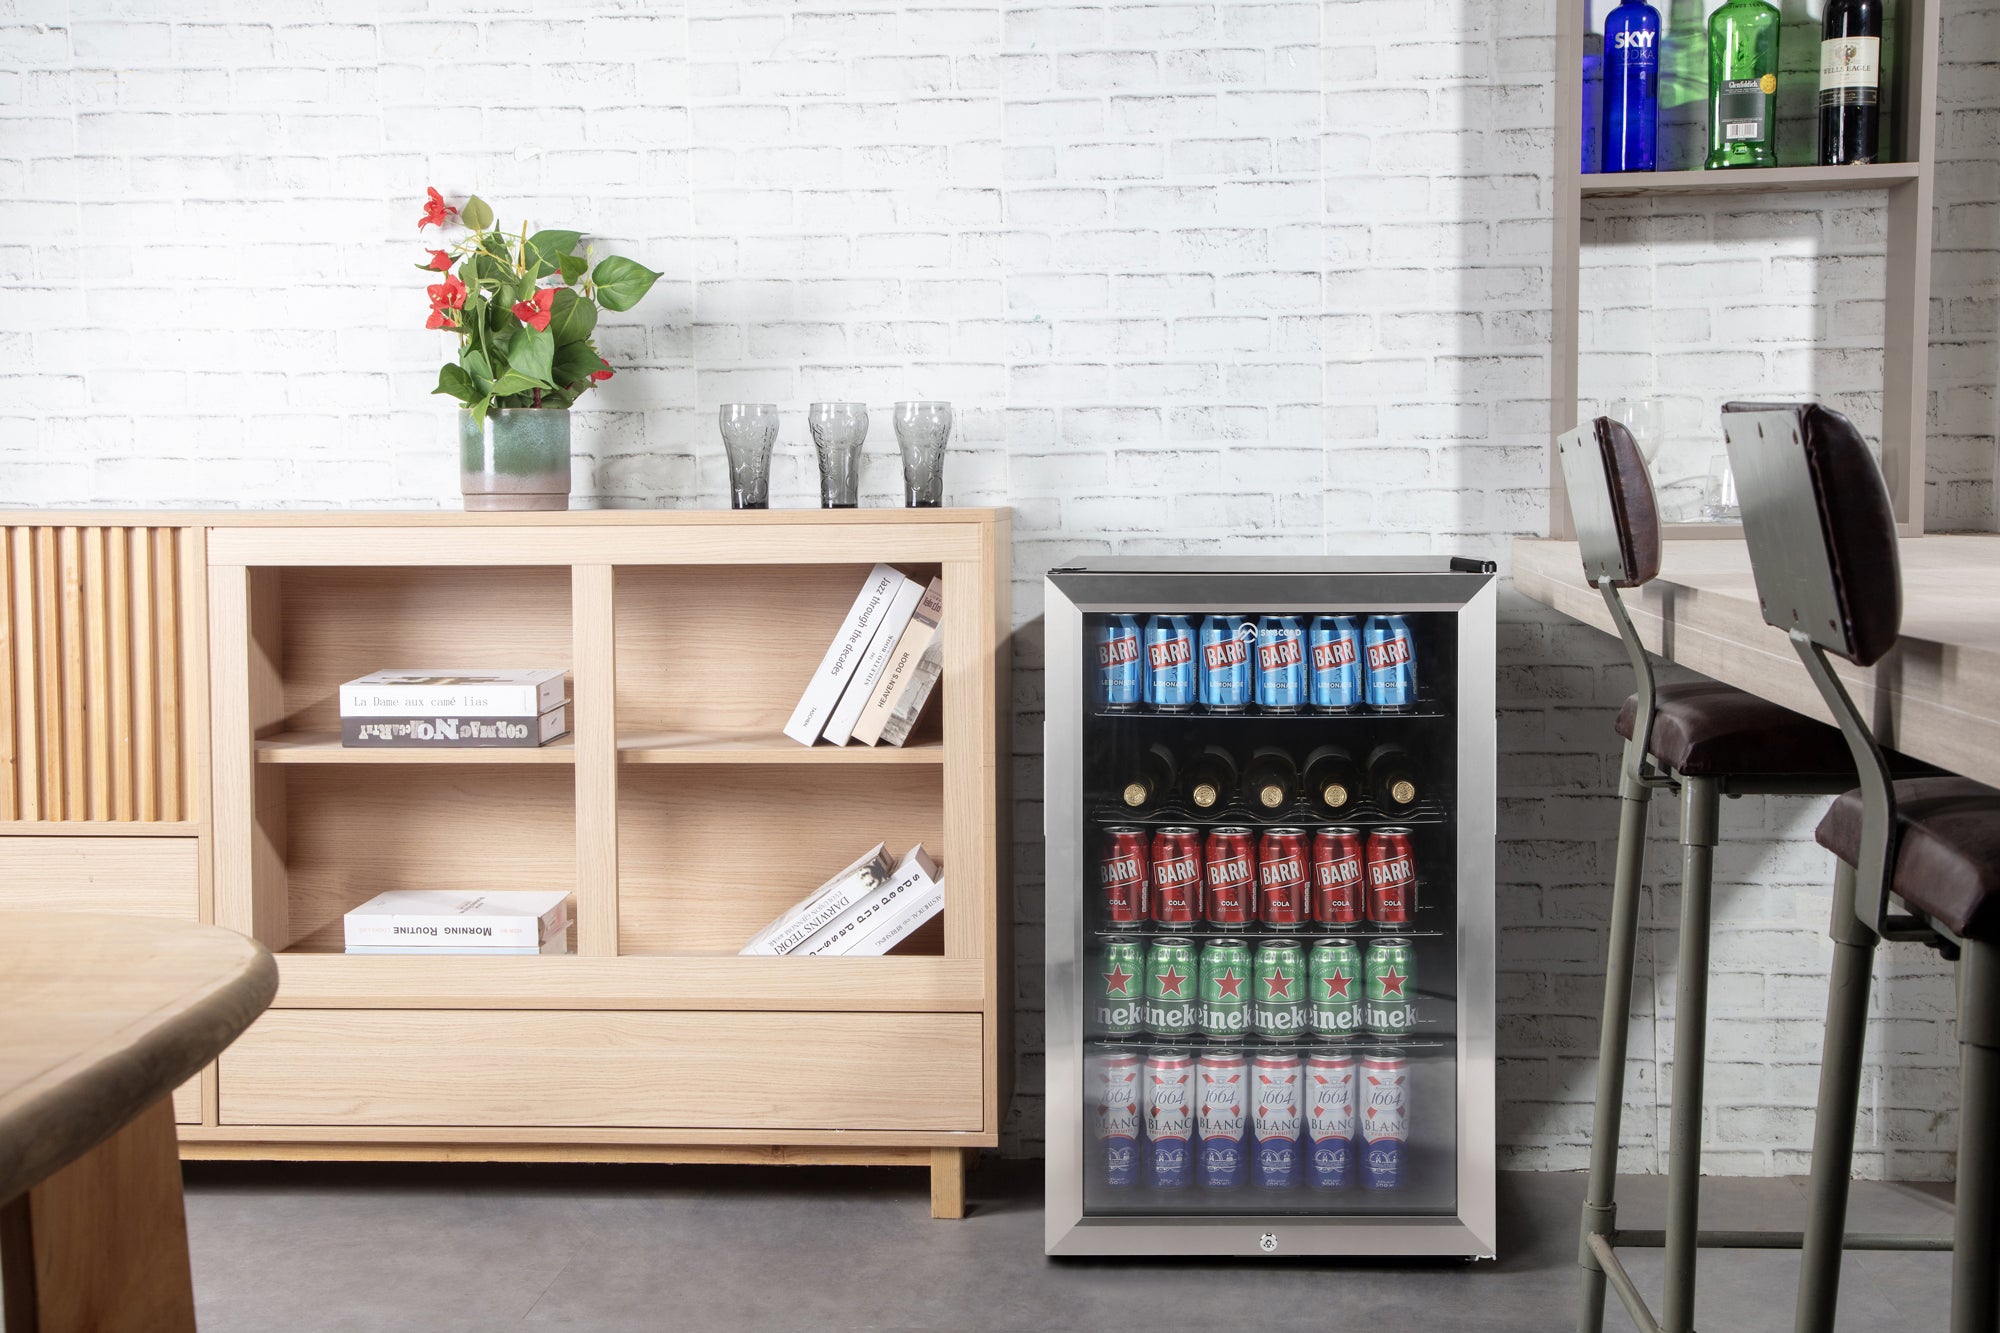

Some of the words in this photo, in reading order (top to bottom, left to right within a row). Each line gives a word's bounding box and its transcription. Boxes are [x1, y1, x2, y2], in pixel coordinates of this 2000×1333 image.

[1614, 31, 1655, 48] SKYY
[1616, 49, 1655, 59] ODKA
[876, 577, 891, 595] Jazz
[858, 595, 880, 628] through
[849, 629, 861, 644] the
[831, 644, 854, 677] decades
[1100, 640, 1138, 664] BARR
[1151, 641, 1190, 666] BARR
[1206, 641, 1246, 667] BARR
[1261, 641, 1300, 667] BARR
[1315, 641, 1354, 667] BARR
[1369, 641, 1409, 667] BARR
[877, 672, 899, 708] HEAVEN'S
[896, 652, 911, 674] DOOR
[354, 697, 367, 707] La
[373, 697, 399, 707] Dame
[405, 699, 425, 707] aux
[430, 697, 456, 707] camé
[464, 697, 488, 707] lias
[460, 720, 528, 739] CORMAC
[1101, 860, 1138, 883] BARR
[1157, 860, 1196, 884] BARR
[1210, 860, 1249, 885] BARR
[1262, 860, 1300, 885] BARR
[1320, 860, 1359, 885] BARR
[1372, 860, 1411, 885] BARR
[880, 873, 920, 906] speed
[803, 894, 850, 934] DARWINS
[855, 903, 880, 924] and
[393, 926, 438, 936] ROUTINE
[444, 927, 492, 937] MORNING
[1254, 1003, 1307, 1029] inek
[1102, 1088, 1132, 1103] 1664
[1154, 1090, 1186, 1104] 1664
[1205, 1089, 1237, 1104] 1664
[1262, 1090, 1294, 1104] 1664
[1318, 1090, 1347, 1104] 1664
[1371, 1090, 1401, 1105] 1664
[1096, 1115, 1139, 1130] BLANC
[1148, 1117, 1192, 1131] BLANC
[1200, 1116, 1243, 1130] BLANC
[1256, 1117, 1299, 1130] BLANC
[1311, 1117, 1354, 1130] BLANC
[1365, 1118, 1408, 1131] BLANC
